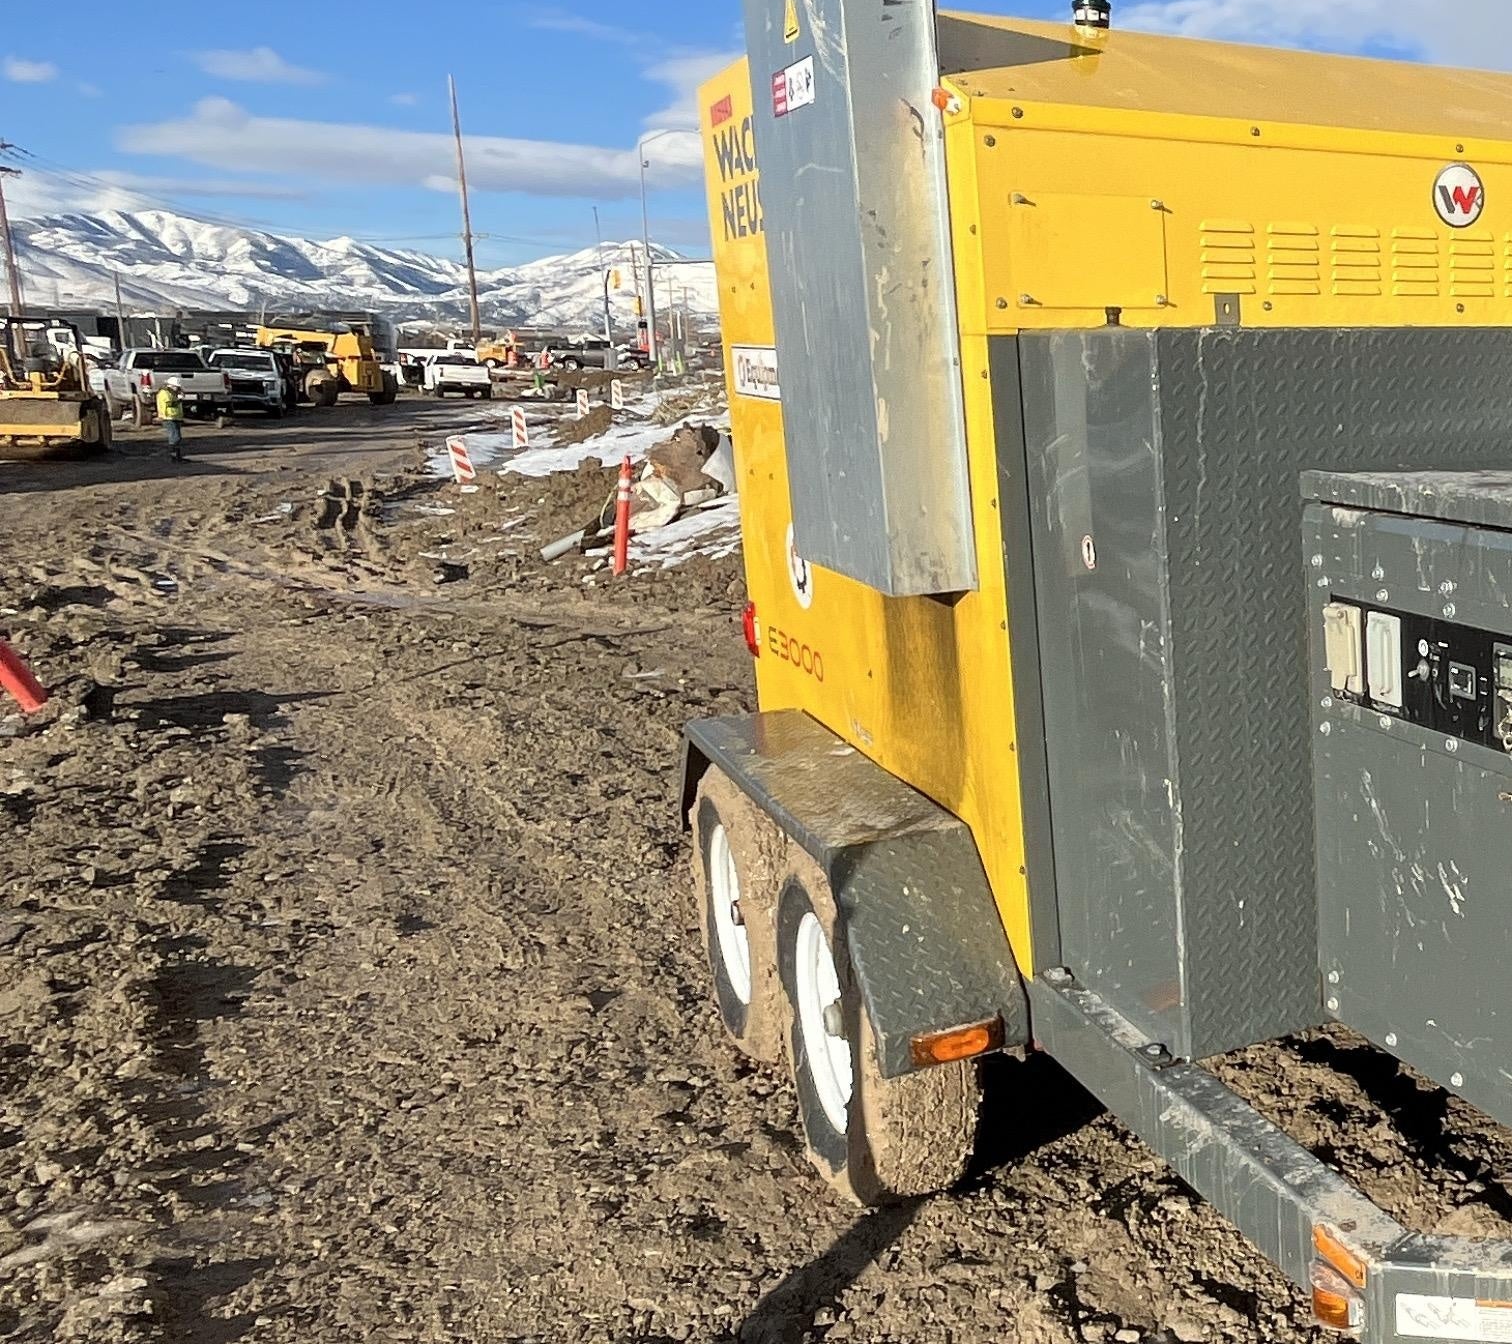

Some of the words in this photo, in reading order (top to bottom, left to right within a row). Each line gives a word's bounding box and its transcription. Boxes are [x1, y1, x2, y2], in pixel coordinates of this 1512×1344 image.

[713, 115, 757, 182] WAC
[721, 179, 764, 242] NEU
[768, 626, 824, 683] E3000
